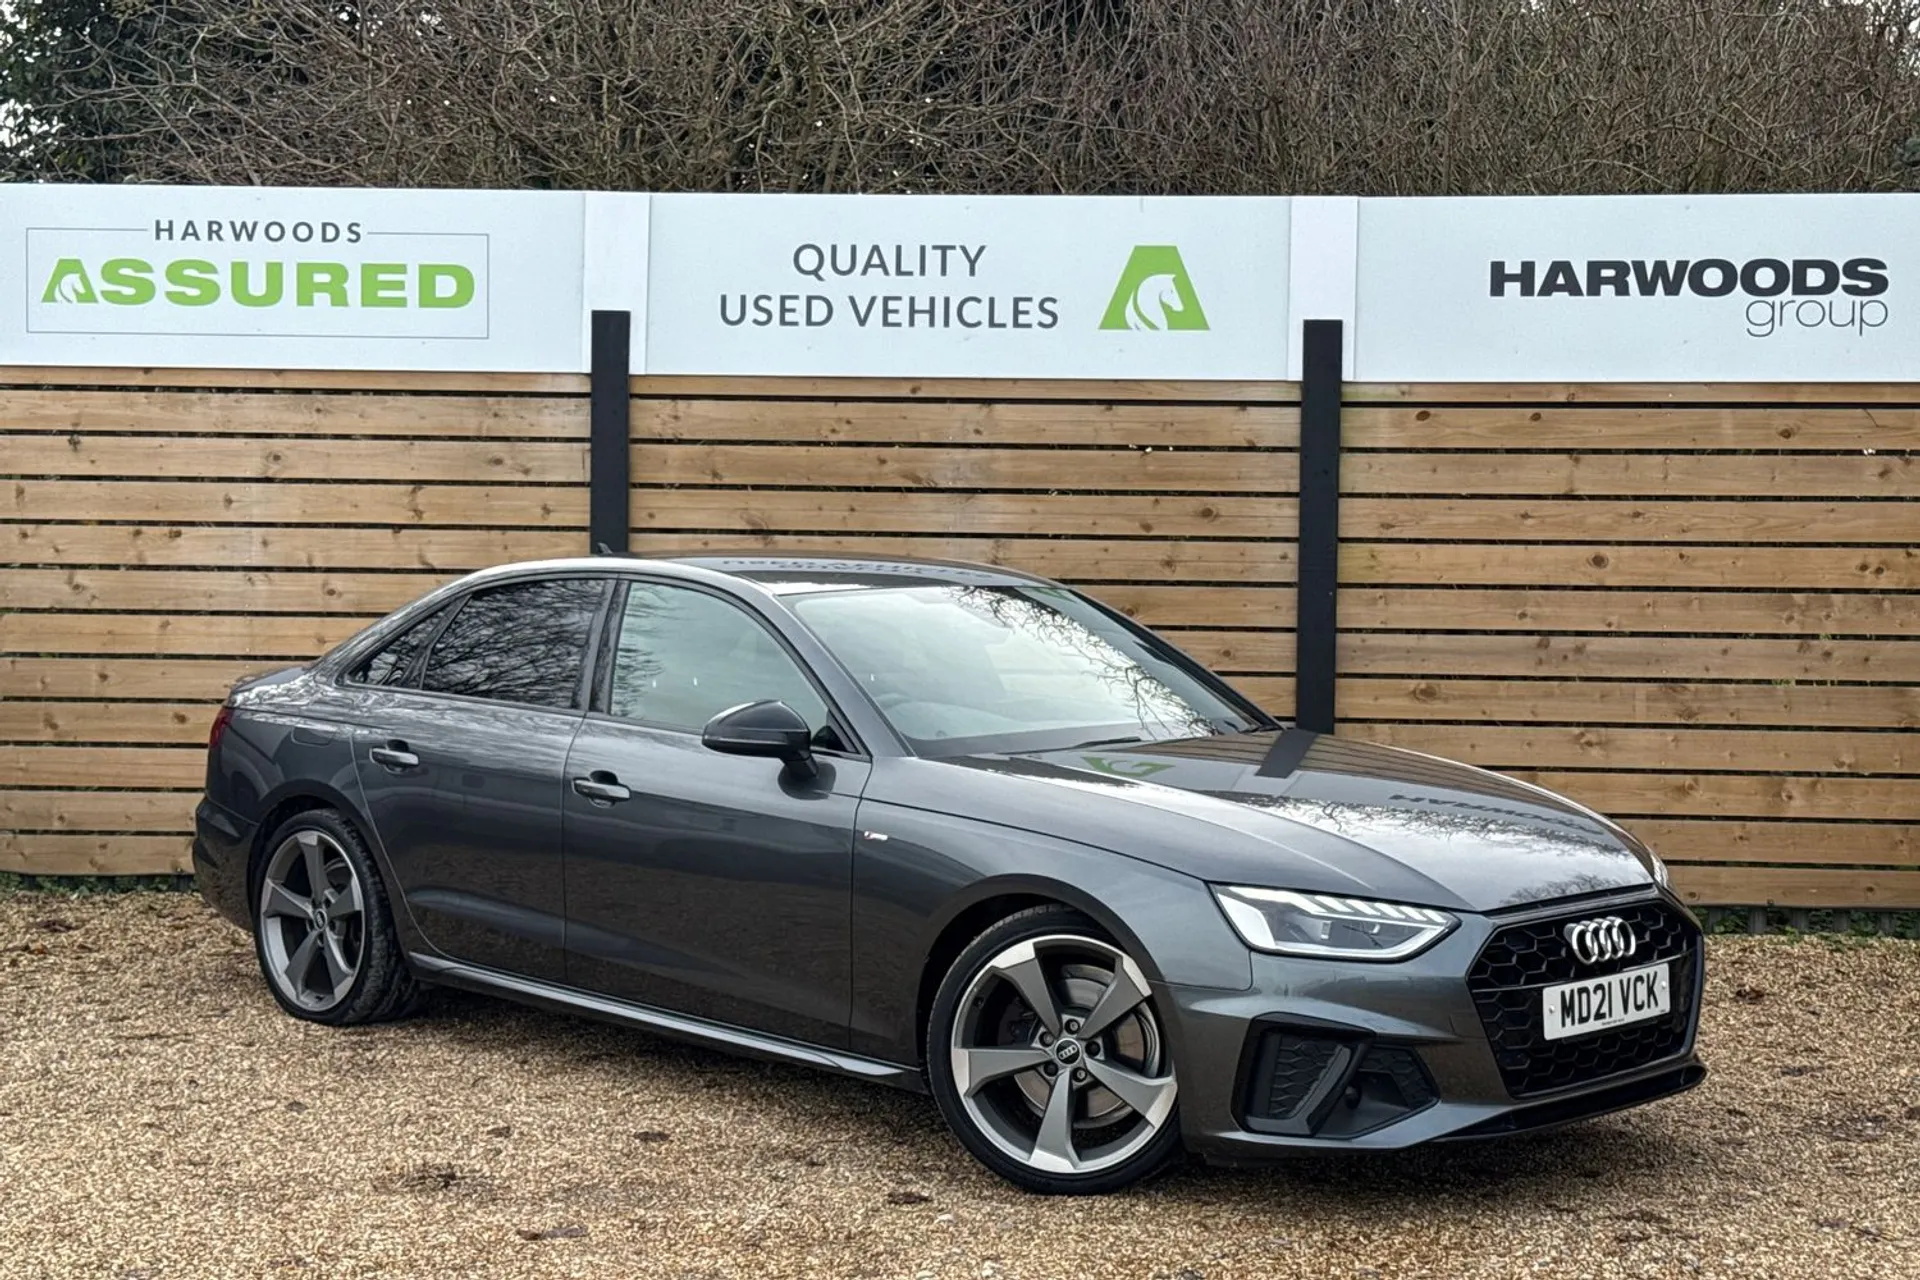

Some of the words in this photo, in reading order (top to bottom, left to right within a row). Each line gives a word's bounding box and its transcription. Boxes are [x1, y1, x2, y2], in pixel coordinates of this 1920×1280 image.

[154, 219, 362, 244] HARWOODS
[792, 243, 987, 282] QUALITY
[1489, 257, 1890, 298] HARWOODS
[41, 257, 476, 309] ASSURED
[719, 294, 834, 327] USED
[848, 295, 1060, 329] VEHICLES
[1745, 299, 1889, 338] group
[1560, 981, 1613, 1028] MD21
[1619, 970, 1659, 1016] VCK
